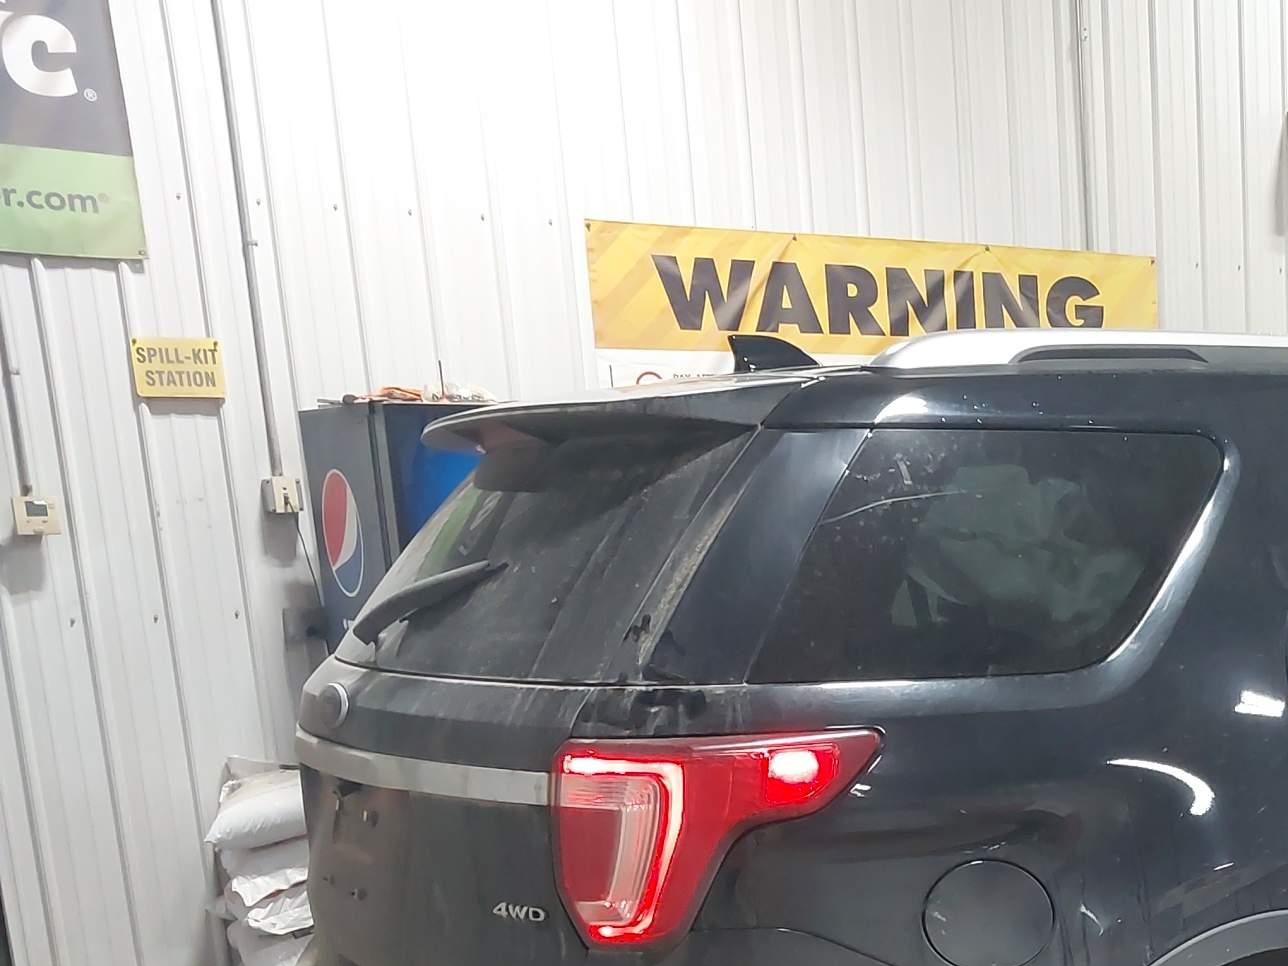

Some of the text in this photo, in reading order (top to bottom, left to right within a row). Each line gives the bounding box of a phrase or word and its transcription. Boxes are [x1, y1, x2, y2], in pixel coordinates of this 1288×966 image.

[0, 10, 78, 97] c
[0, 187, 99, 213] r.com
[652, 254, 1105, 336] WARNING
[136, 347, 217, 364] SPILL-KIT
[145, 370, 216, 387] STATION
[493, 902, 545, 921] 4WD
